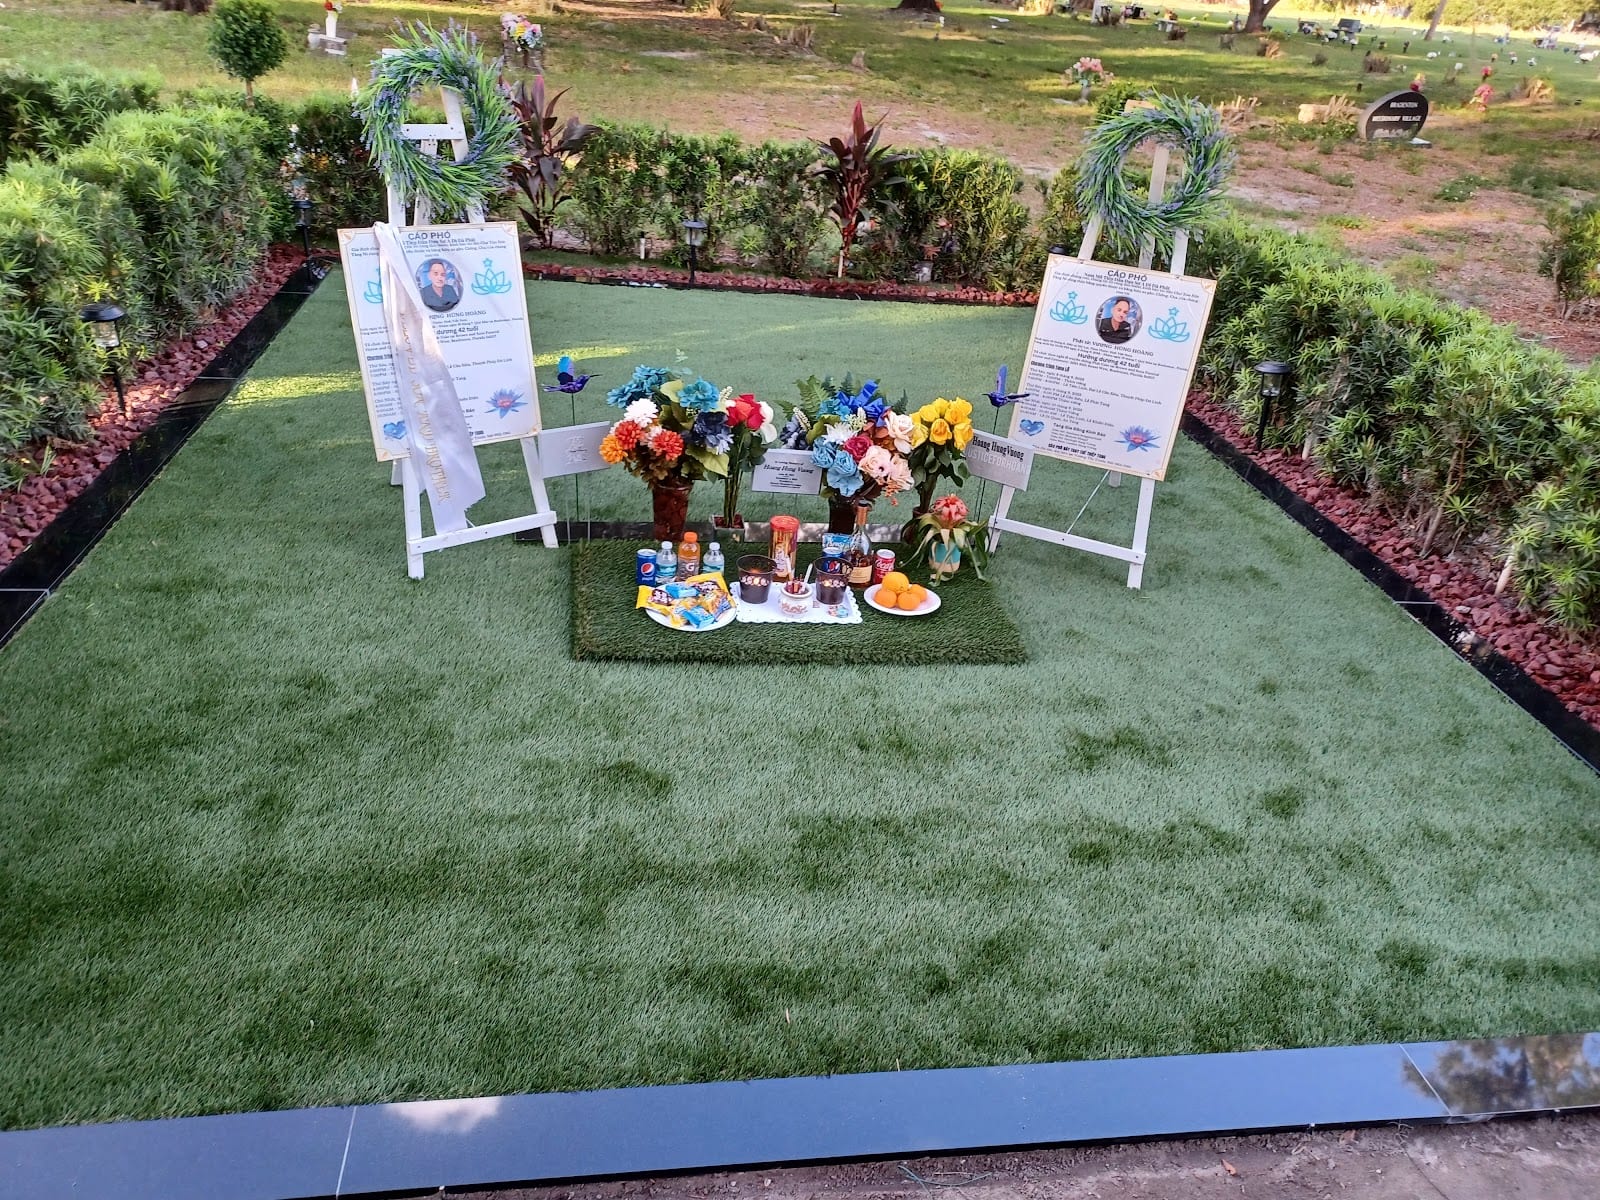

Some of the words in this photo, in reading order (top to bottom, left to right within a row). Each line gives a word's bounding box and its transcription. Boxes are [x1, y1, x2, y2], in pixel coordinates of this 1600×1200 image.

[972, 436, 991, 452] Hoang
[424, 444, 452, 506] BROTHER
[686, 563, 694, 571] G
